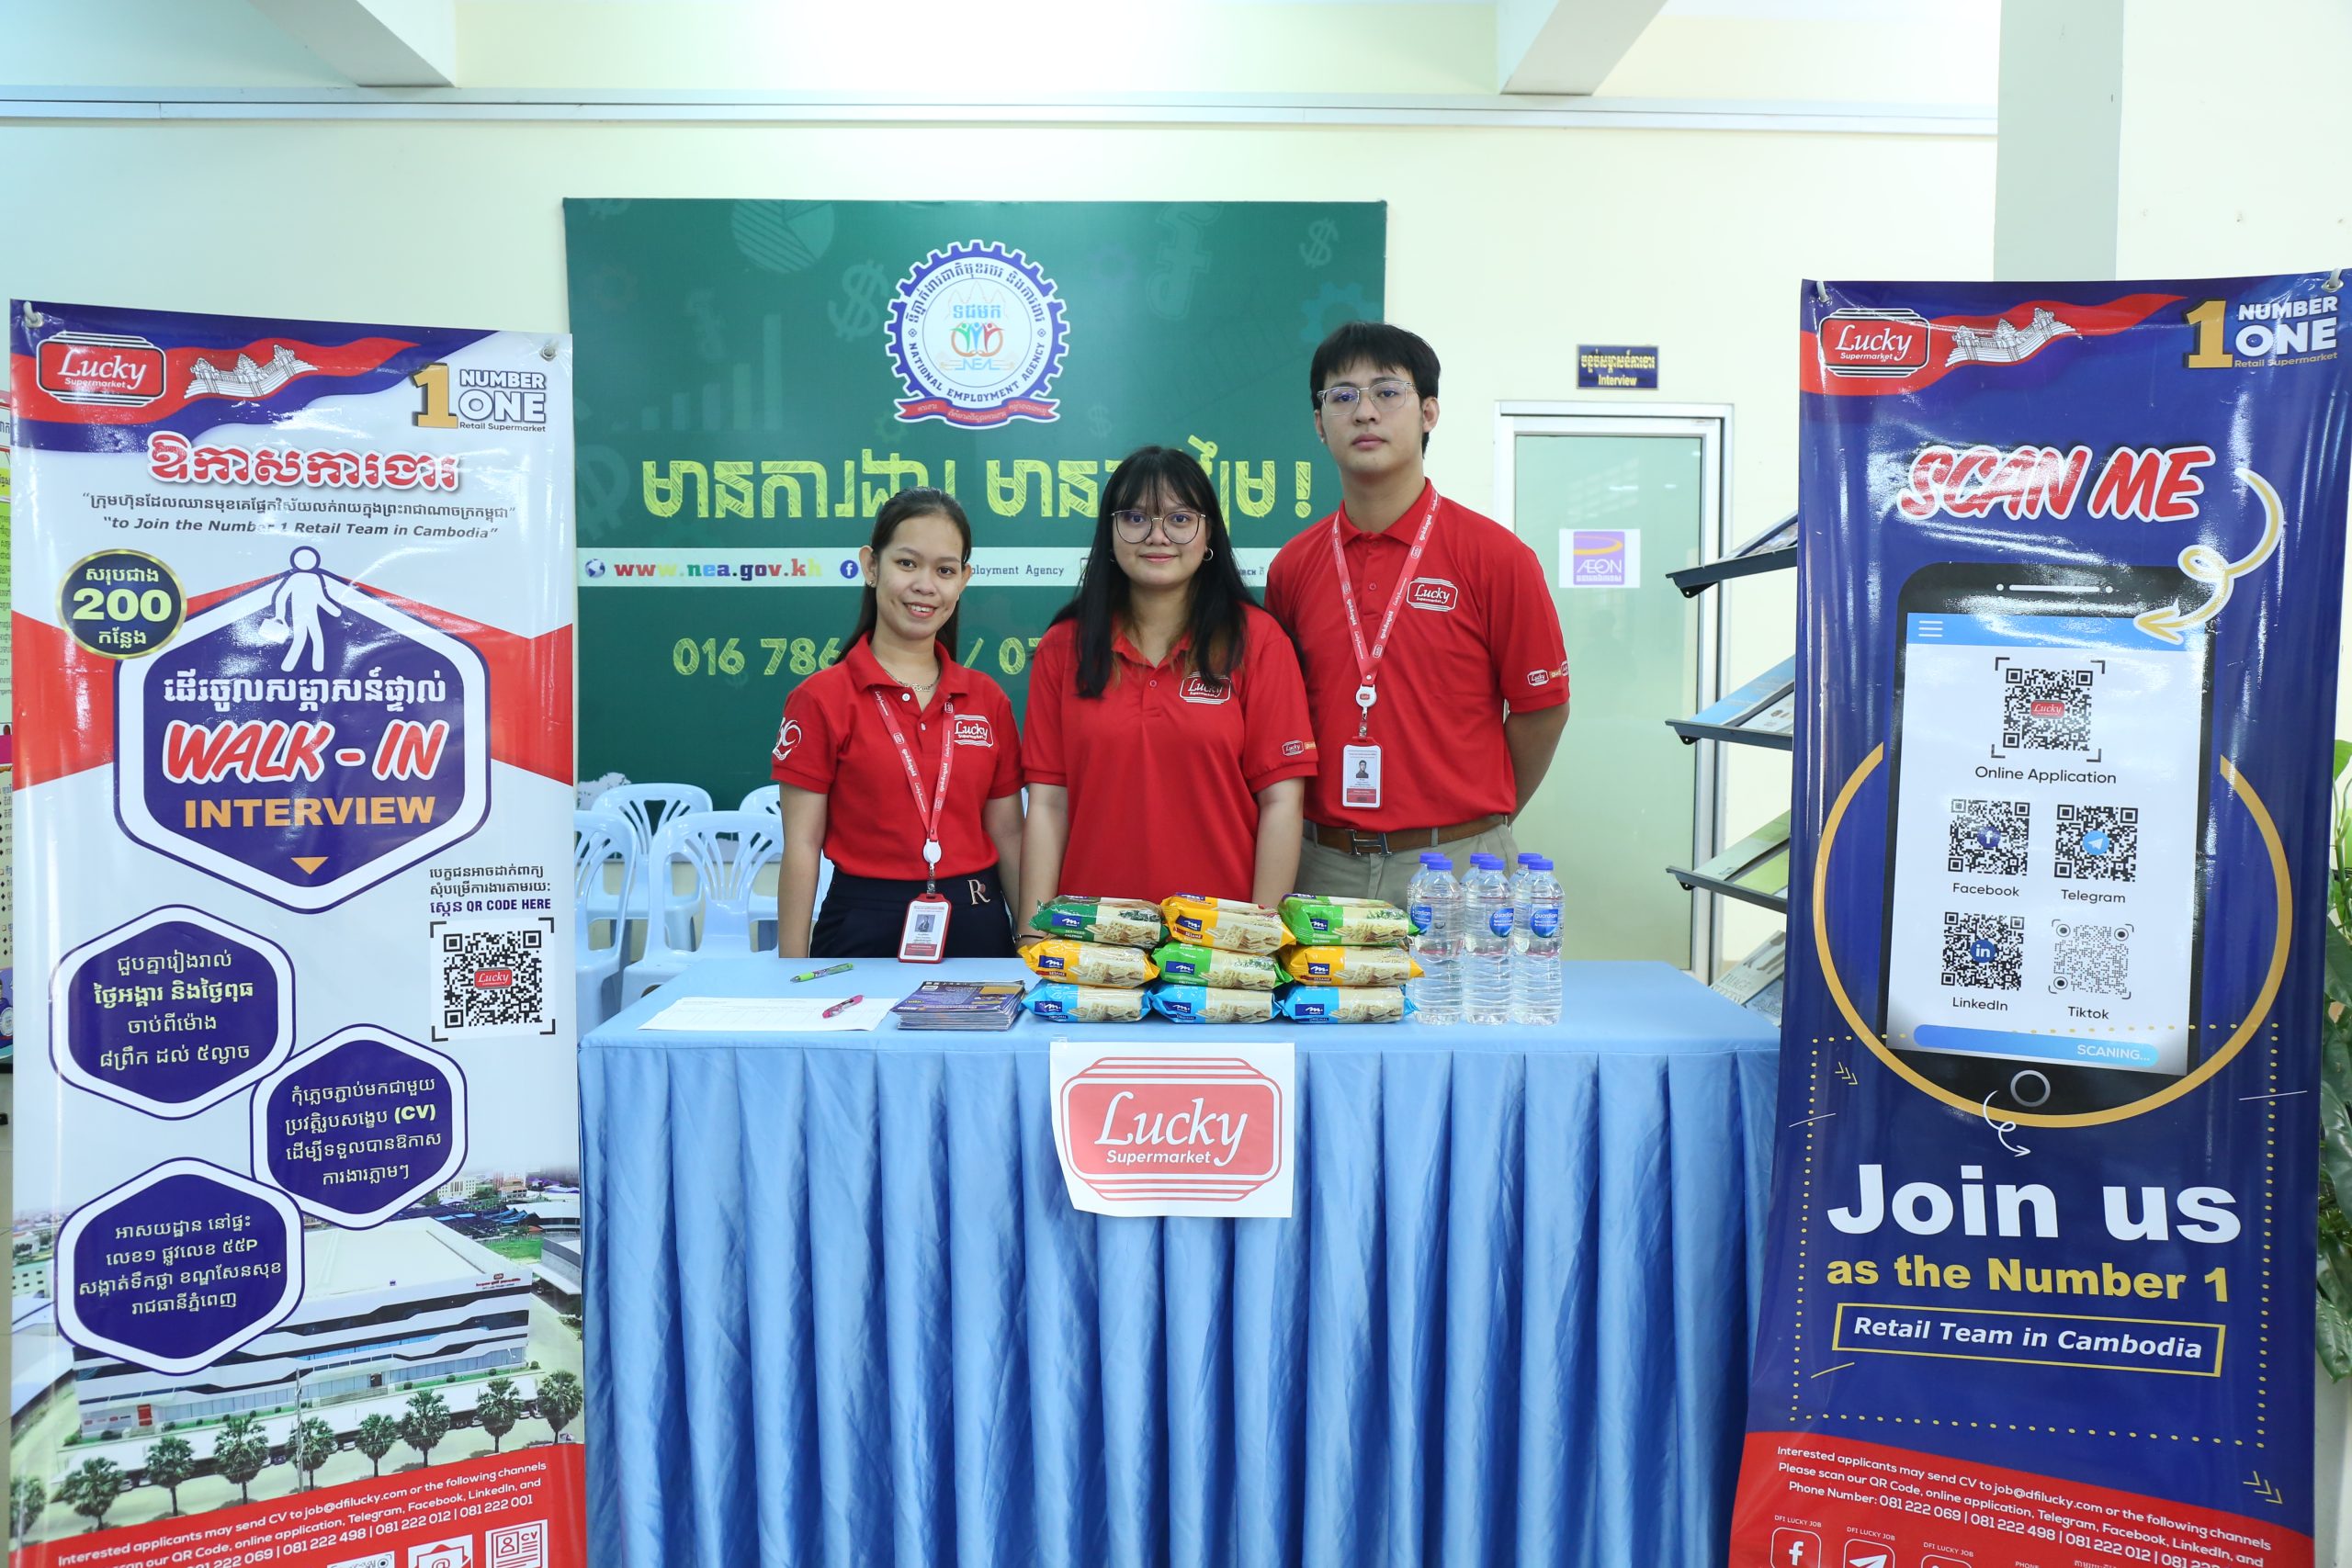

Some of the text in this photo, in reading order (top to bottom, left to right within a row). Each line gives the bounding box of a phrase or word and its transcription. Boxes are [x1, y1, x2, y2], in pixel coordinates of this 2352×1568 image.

[2238, 296, 2338, 321] NUMBER
[1835, 324, 1913, 361] Lucky
[2186, 299, 2233, 368] 1
[2235, 317, 2337, 356] ONE
[1840, 352, 1893, 360] Supermarket
[2234, 352, 2338, 367] Retail Supermarket
[57, 348, 147, 389] Lucky
[459, 369, 546, 389] NUMBER
[909, 343, 1046, 401] NATIONAL EMPLOYMENT AGENCY
[1598, 374, 1637, 386] Interview
[64, 378, 126, 389] Supermarket
[413, 364, 458, 429] 1
[458, 389, 546, 423] ONE
[459, 422, 546, 432] Retail Supermarket
[1896, 445, 2216, 523] SCAN ME
[134, 517, 169, 530] Join
[175, 519, 203, 531] the
[295, 522, 341, 534] Retail
[345, 524, 389, 535] Team
[394, 525, 408, 536] in
[614, 558, 822, 581] www.nea.gov.kh
[1025, 565, 1065, 577] Agency
[73, 588, 172, 622] 200
[1414, 583, 1451, 604] Lucky
[673, 637, 745, 676] 016
[2033, 704, 2062, 714] Lucky
[955, 721, 988, 740] Lucky
[163, 718, 450, 784] WALK IN
[1974, 766, 2117, 784] Online Application
[186, 796, 435, 828] INTERVIEW
[1952, 883, 2020, 897] Facebook
[2061, 889, 2126, 904] Telegram
[467, 900, 482, 912] QR
[487, 899, 517, 910] CODE
[522, 898, 551, 909] HERE
[478, 972, 510, 983] Lucky
[1952, 997, 2008, 1011] LinkedIn
[2067, 1006, 2109, 1020] Tiktok
[2076, 1044, 2151, 1062] SCANING...
[394, 1104, 435, 1123] (CV)
[1094, 1090, 1248, 1167] Lucky
[1106, 1150, 1212, 1166] Supermarket
[1826, 1163, 2242, 1244] Join us
[1826, 1254, 2228, 1303] as the Number 1
[1853, 1315, 2203, 1359] Retail Team in Cambodia
[1777, 1446, 2271, 1551] Interested applicants may send CV to job@dfilucky.com or the following channels
[59, 1543, 130, 1567] Interested
[133, 1531, 202, 1553] applicants
[205, 1526, 232, 1539] may
[235, 1517, 266, 1532] send
[268, 1512, 287, 1524] CV
[289, 1510, 302, 1519] to
[303, 1489, 407, 1520] job@dfilucky.com
[410, 1486, 423, 1495] or
[424, 1482, 444, 1492] the
[446, 1472, 496, 1487] following
[498, 1461, 547, 1478] channels
[172, 1478, 541, 1562] QR online and
[1779, 1462, 1815, 1476] Please
[1819, 1471, 1845, 1481] scan
[1847, 1475, 1867, 1484] our
[1869, 1477, 1887, 1488] QR
[1926, 1489, 1962, 1503] online
[2235, 1554, 2264, 1568] and
[1789, 1481, 2056, 1540] Phone Number: 081 222 069 081 222 498
[244, 1494, 533, 1564] 069 001
[1787, 1517, 1808, 1525] LUCKY
[1809, 1519, 1822, 1528] JOB
[521, 1531, 537, 1542] CV
